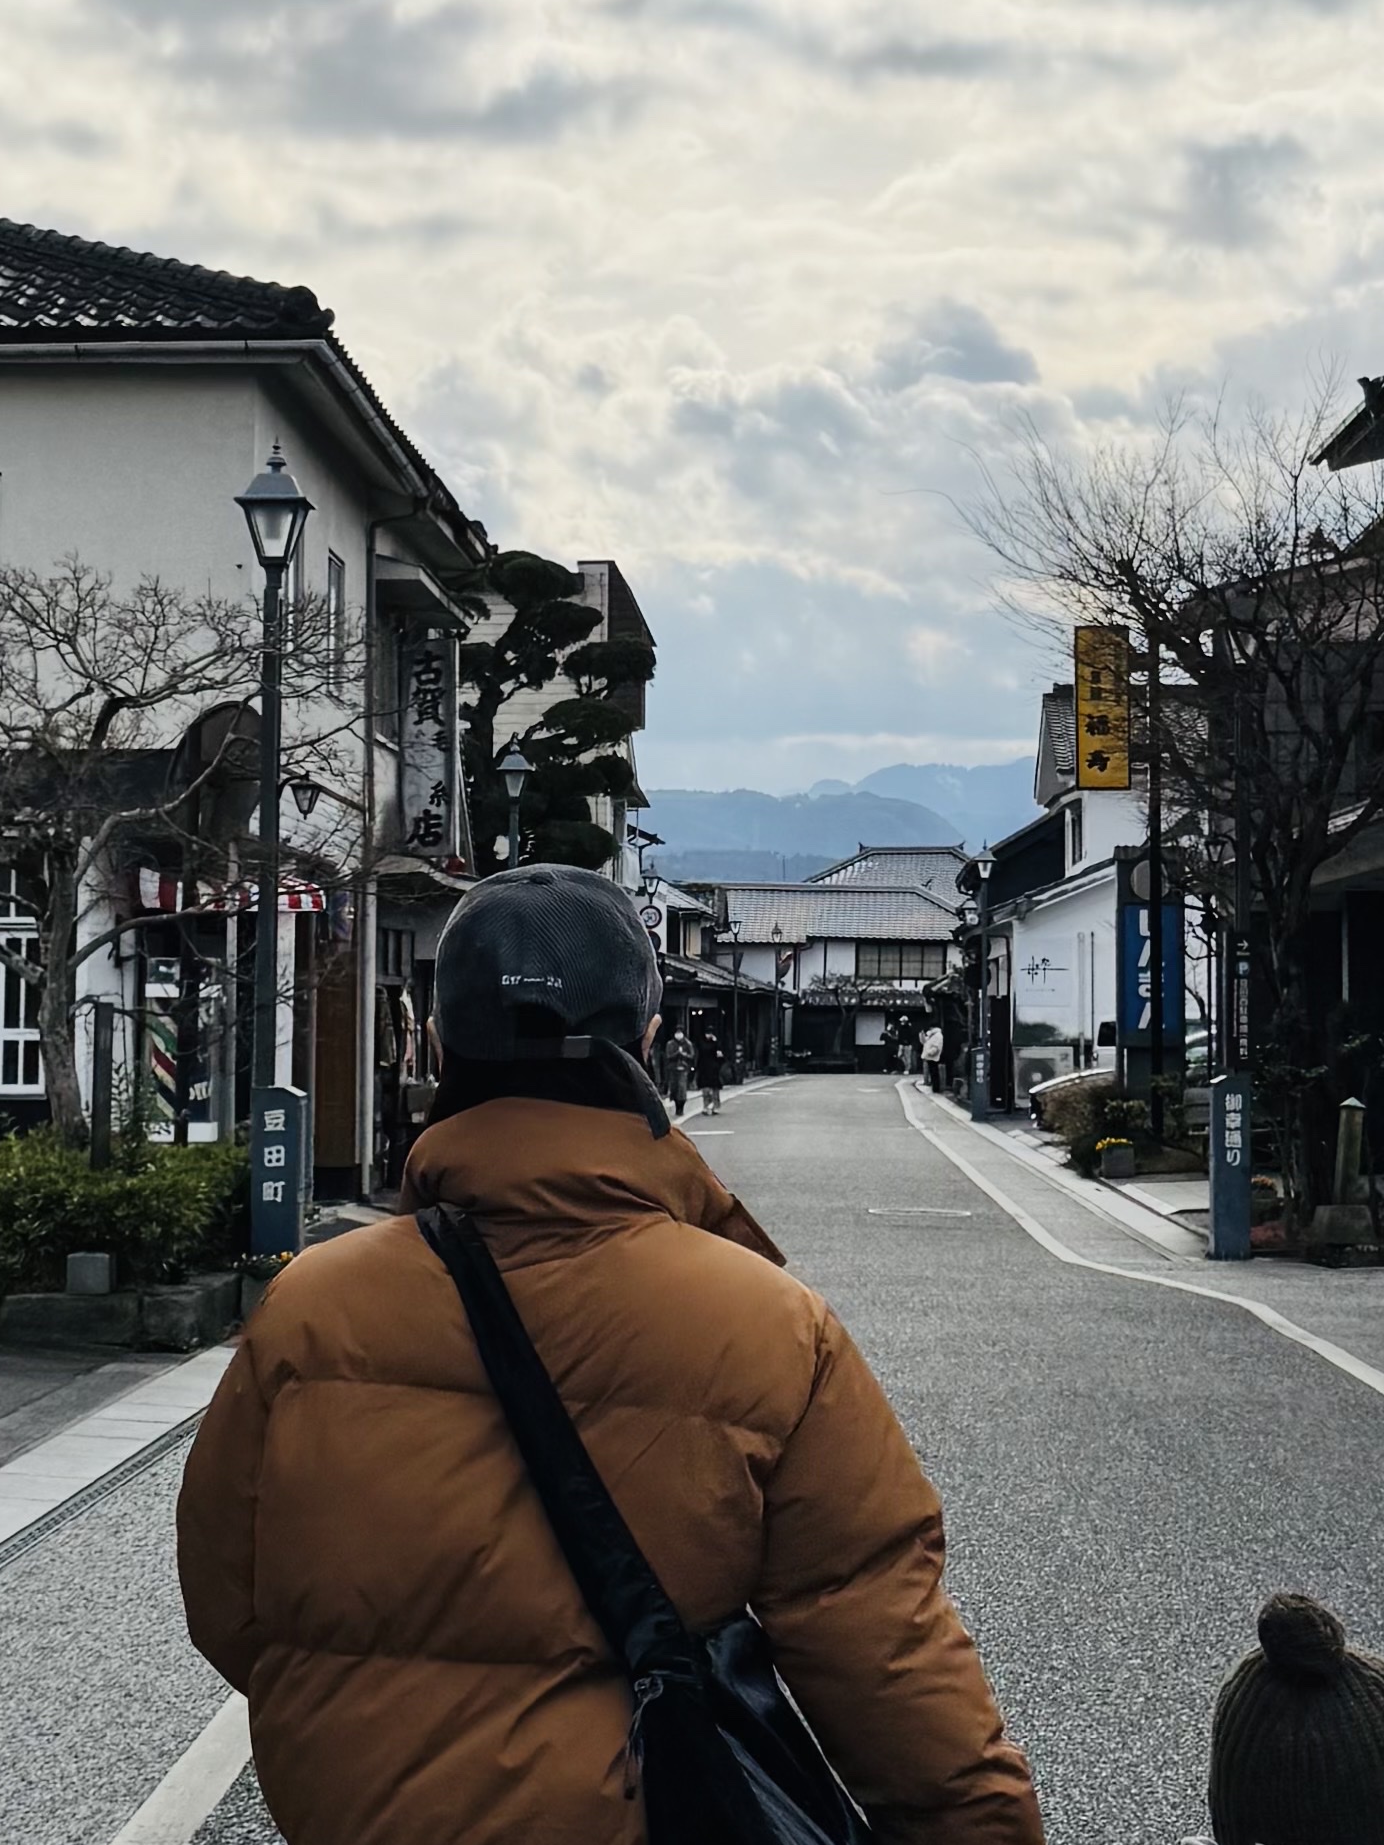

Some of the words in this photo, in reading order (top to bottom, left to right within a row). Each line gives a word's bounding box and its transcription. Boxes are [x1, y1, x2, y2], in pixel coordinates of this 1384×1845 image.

[262, 1109, 286, 1203] 豆田町
[1224, 1093, 1243, 1167] 御幸通り
